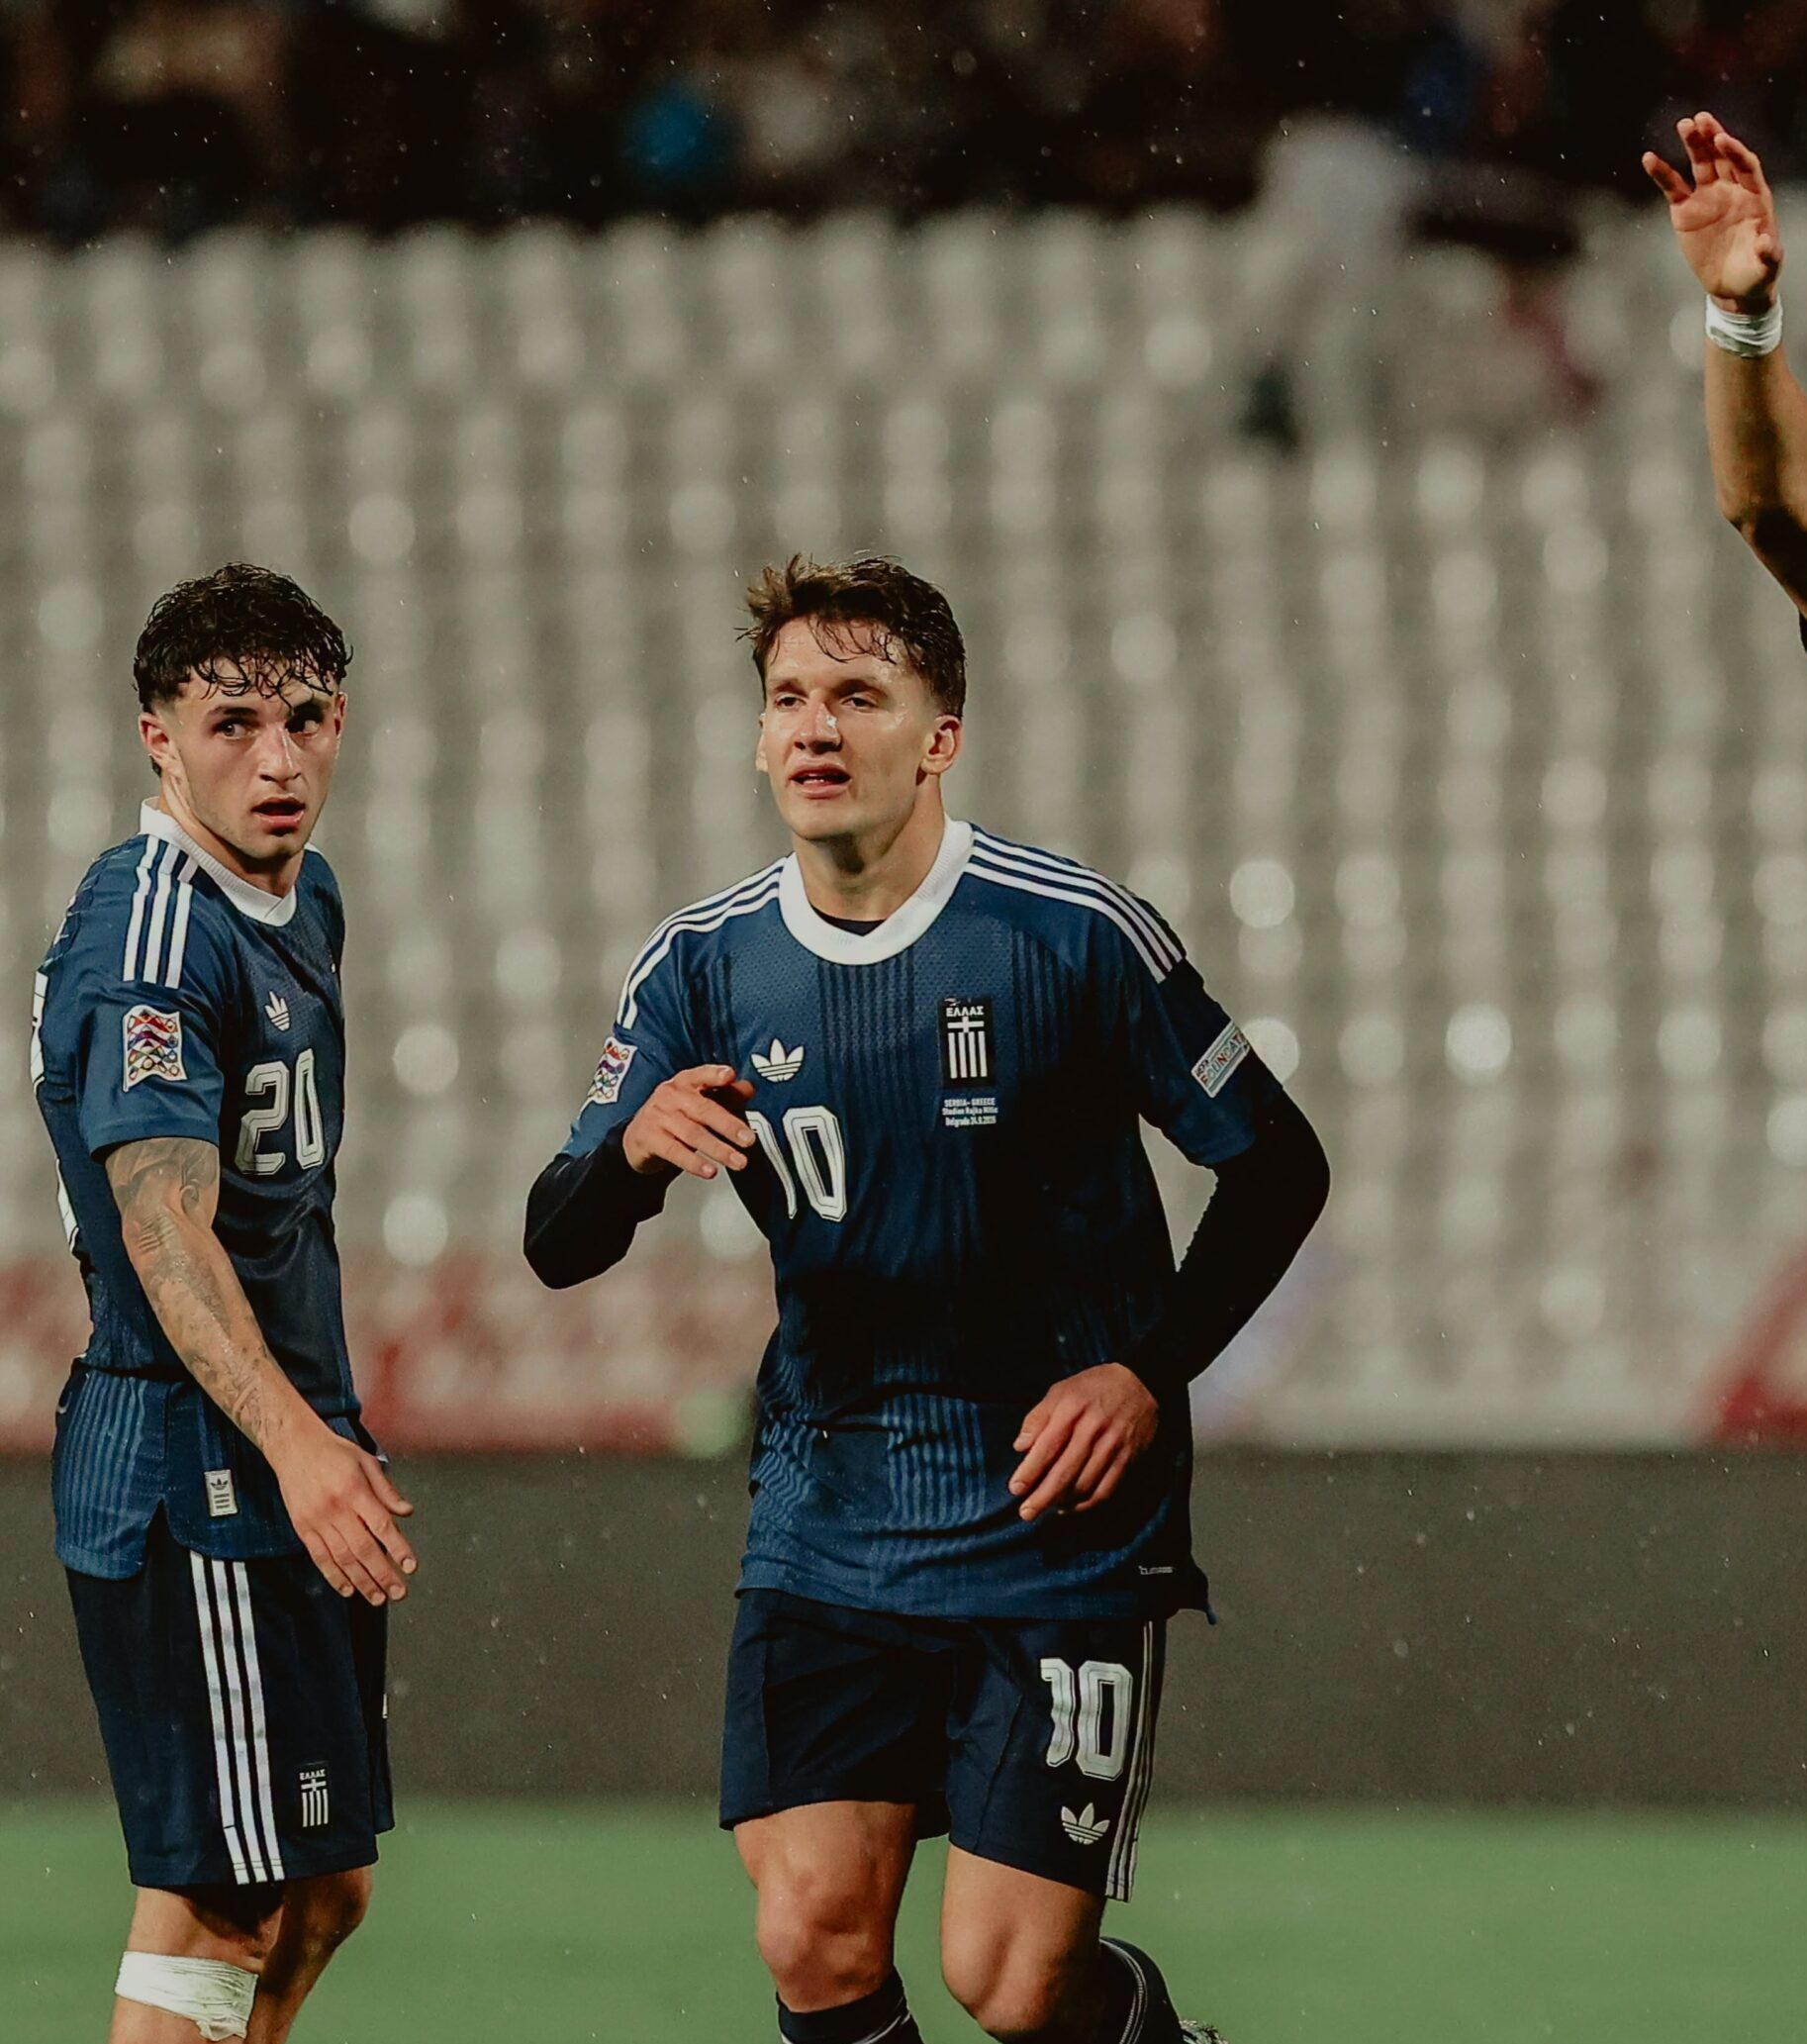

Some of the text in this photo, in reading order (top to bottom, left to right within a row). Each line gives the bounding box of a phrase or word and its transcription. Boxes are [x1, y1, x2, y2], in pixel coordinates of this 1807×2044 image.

[945, 1006, 985, 1017] ΕΛΛΑΣ
[235, 1048, 325, 1175] 20
[745, 1106, 847, 1222] 10
[1040, 1658, 1133, 1781] 10
